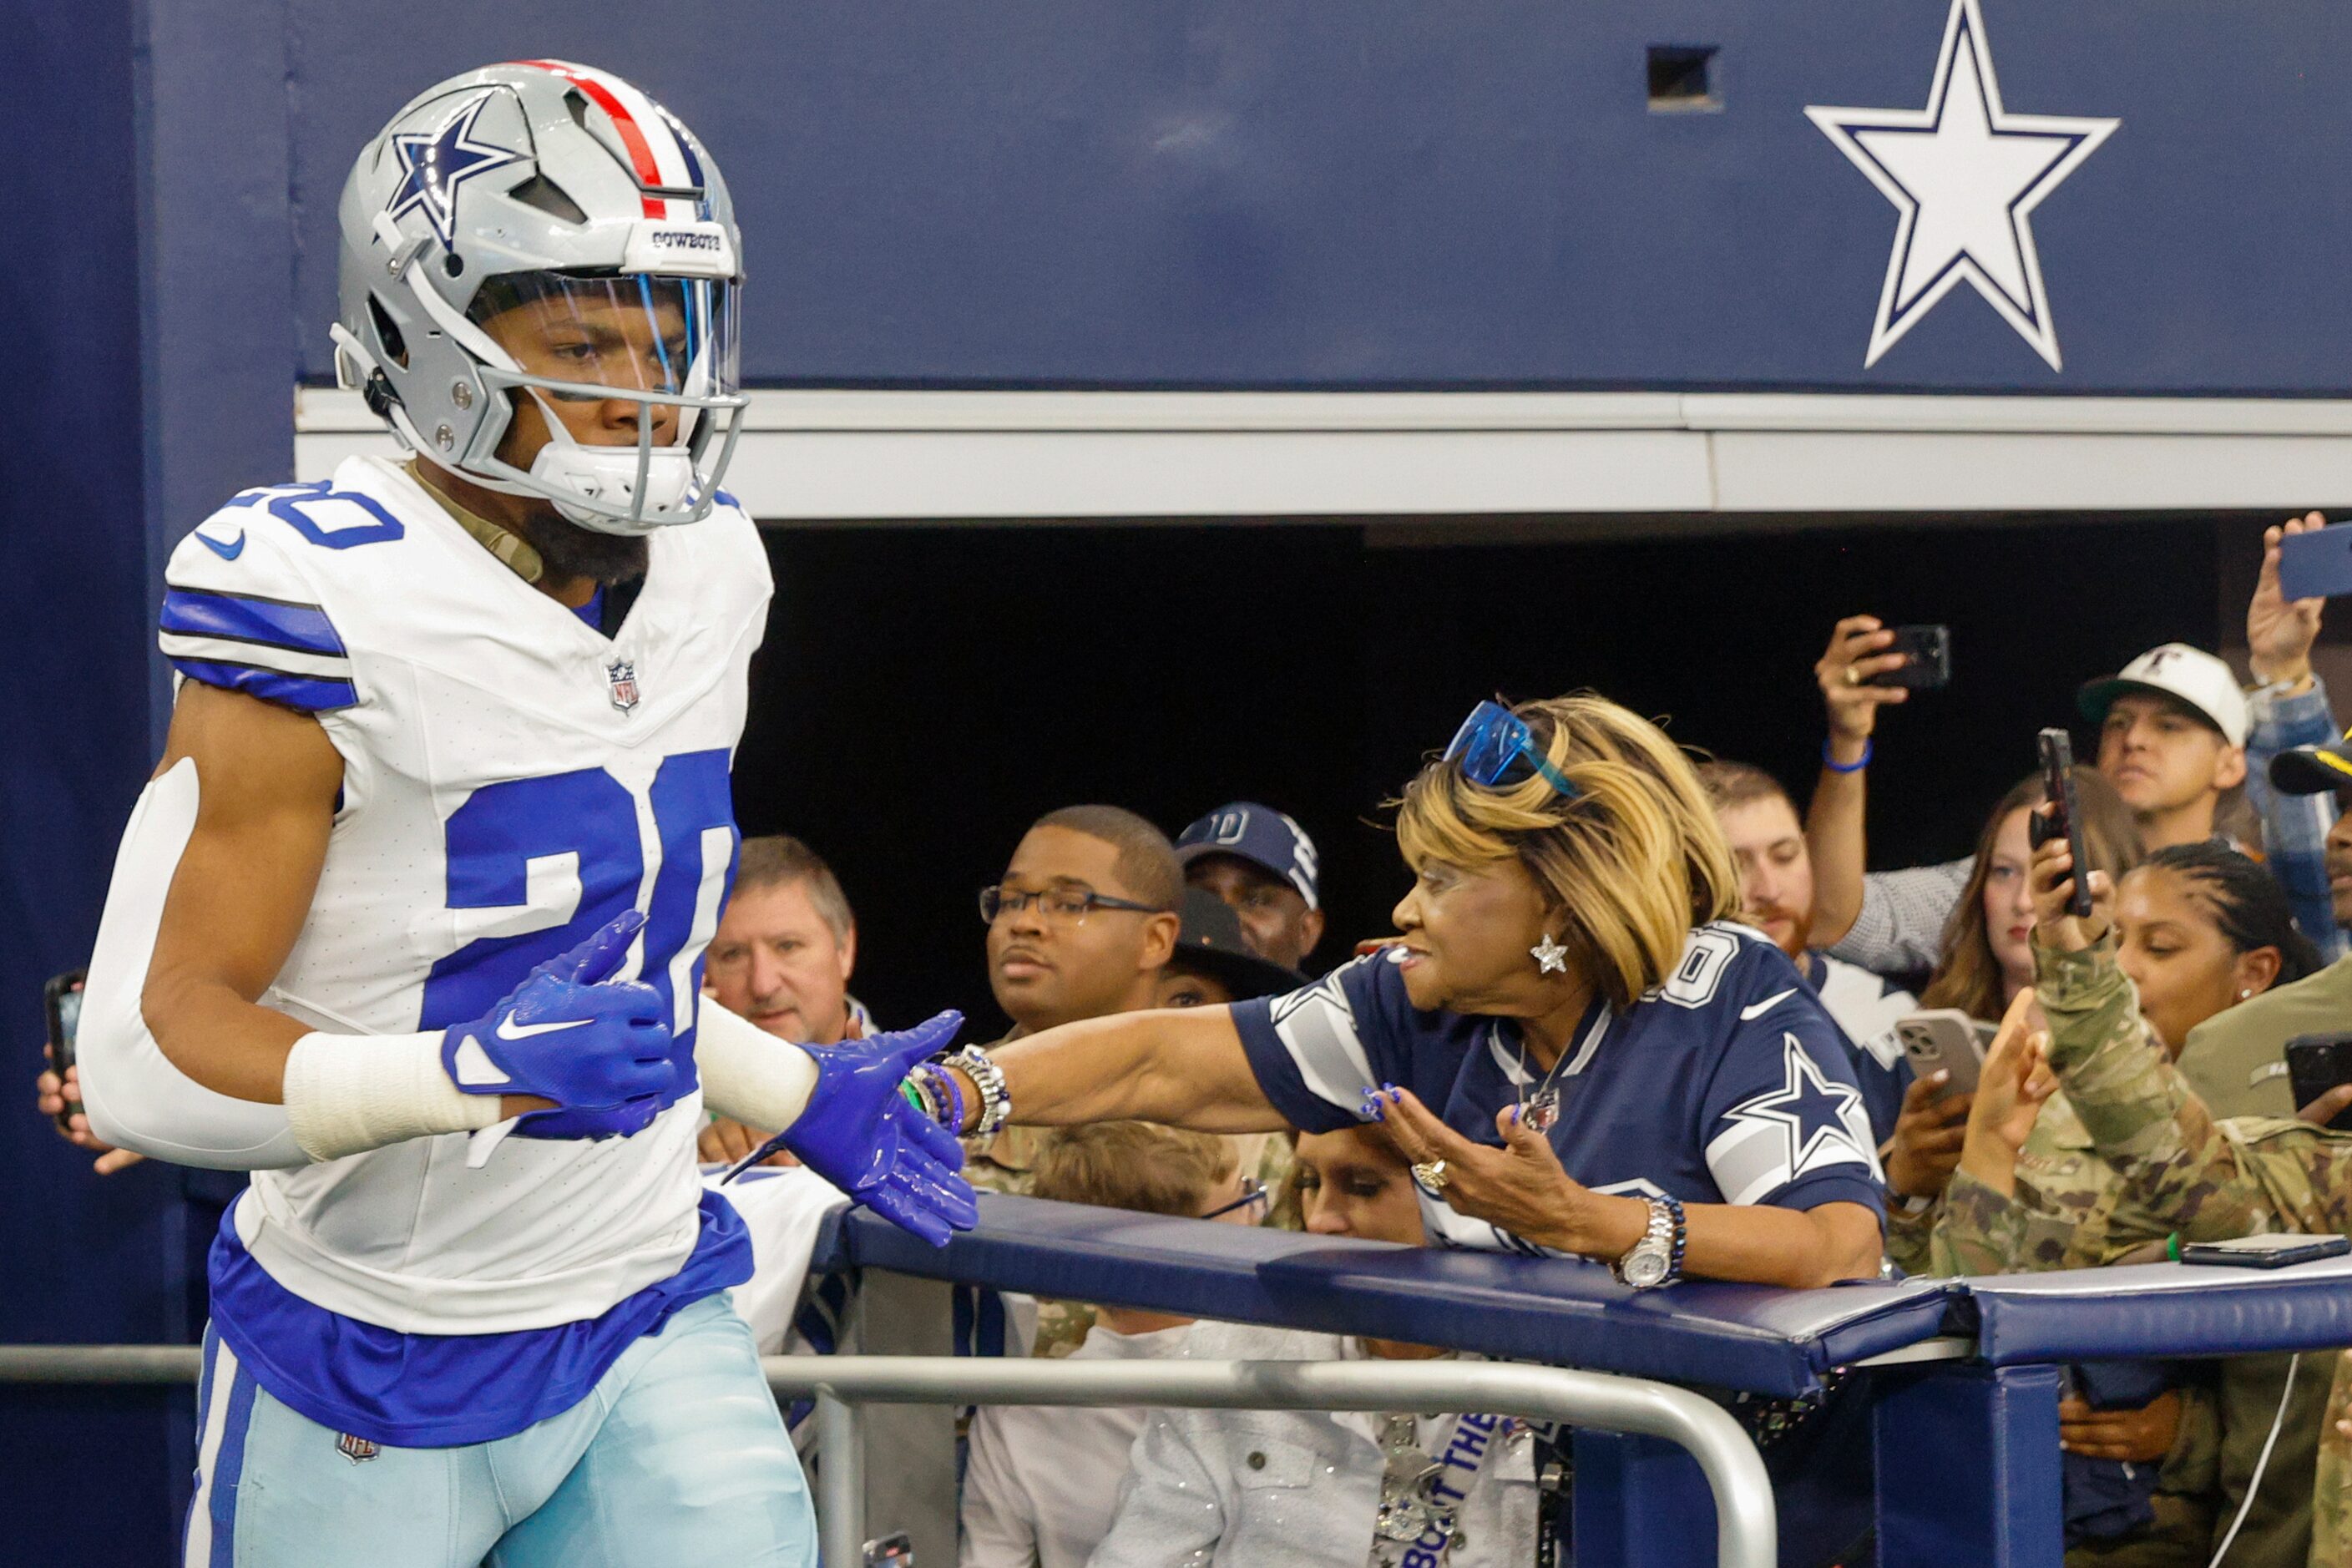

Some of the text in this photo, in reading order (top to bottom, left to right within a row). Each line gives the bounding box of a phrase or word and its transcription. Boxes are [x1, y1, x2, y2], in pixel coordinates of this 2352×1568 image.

[653, 231, 721, 250] COWBOYS
[614, 681, 639, 703] NFL
[417, 747, 741, 1107] 20
[342, 1432, 373, 1454] NFL
